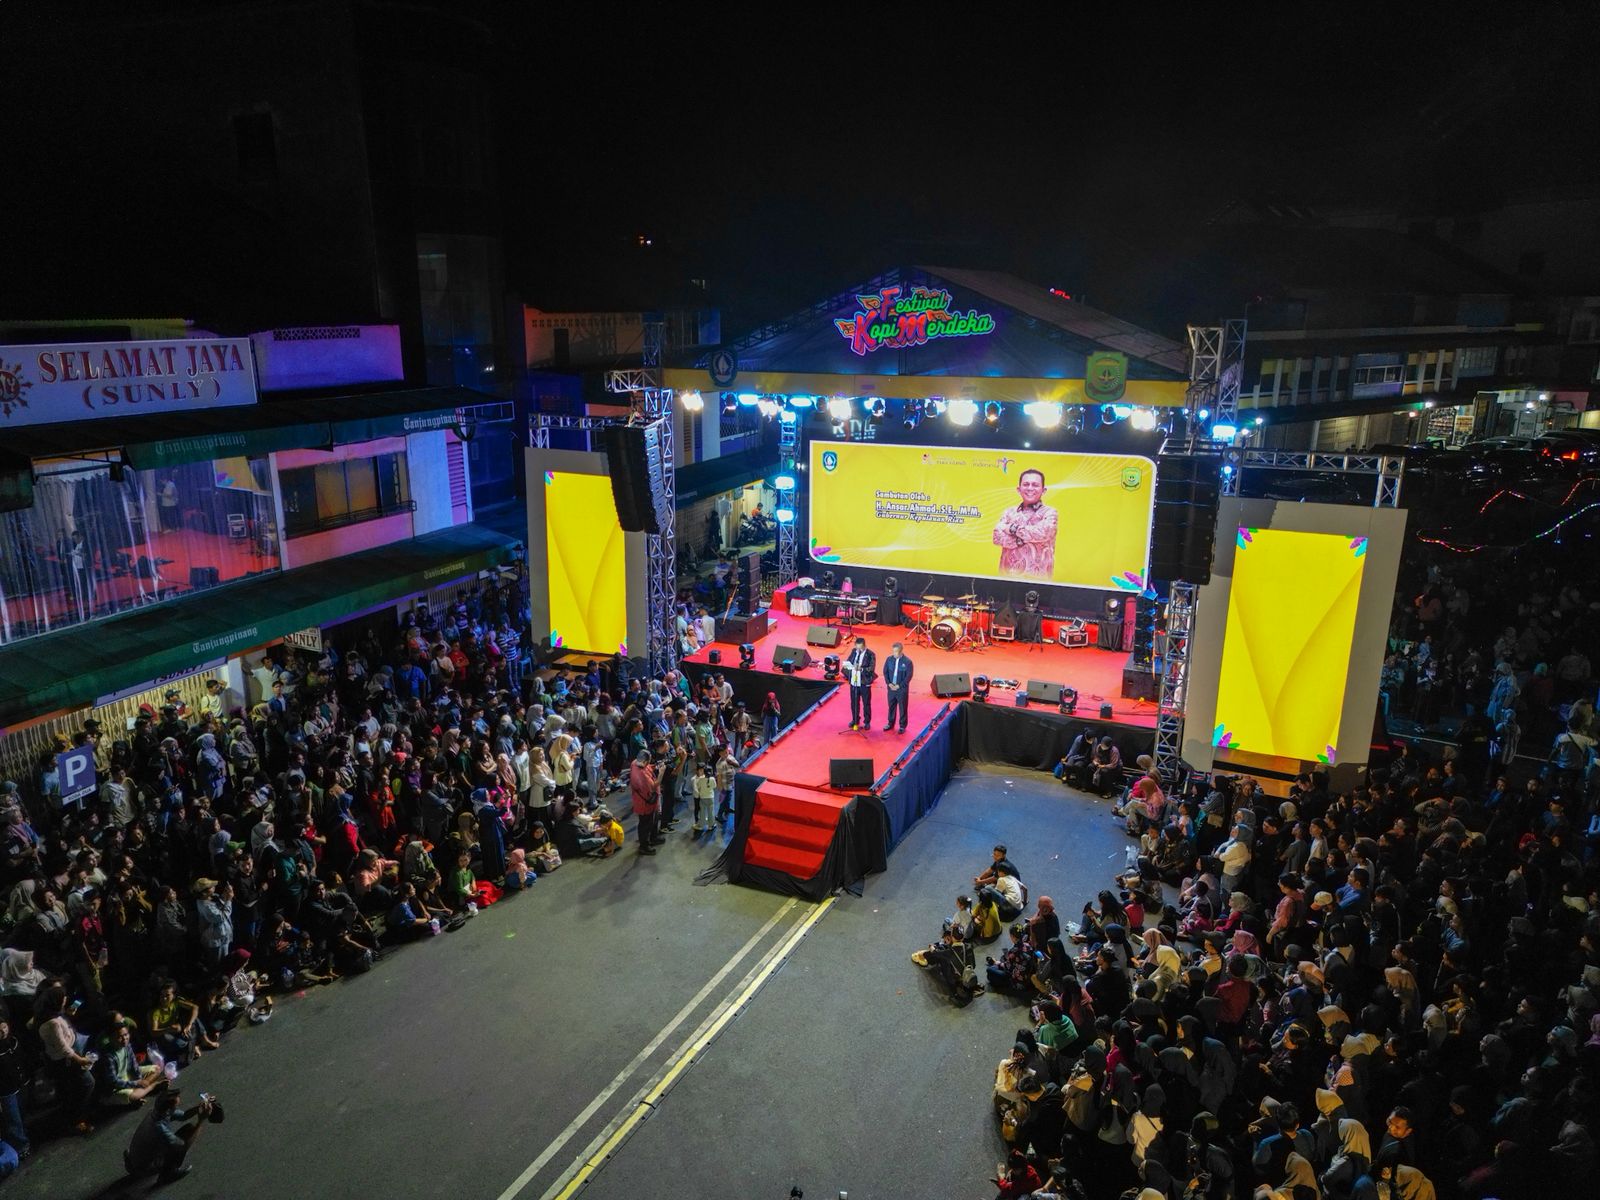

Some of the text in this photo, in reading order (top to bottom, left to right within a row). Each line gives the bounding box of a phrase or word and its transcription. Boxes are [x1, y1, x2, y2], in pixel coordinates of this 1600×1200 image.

[880, 287, 949, 321] Festival
[854, 308, 994, 351] Kopi Merdeka
[38, 344, 245, 384] SELAMAT JAYA
[875, 490, 909, 500] Sambutan
[193, 627, 258, 654] Tanjungpinang
[65, 754, 88, 788] P
